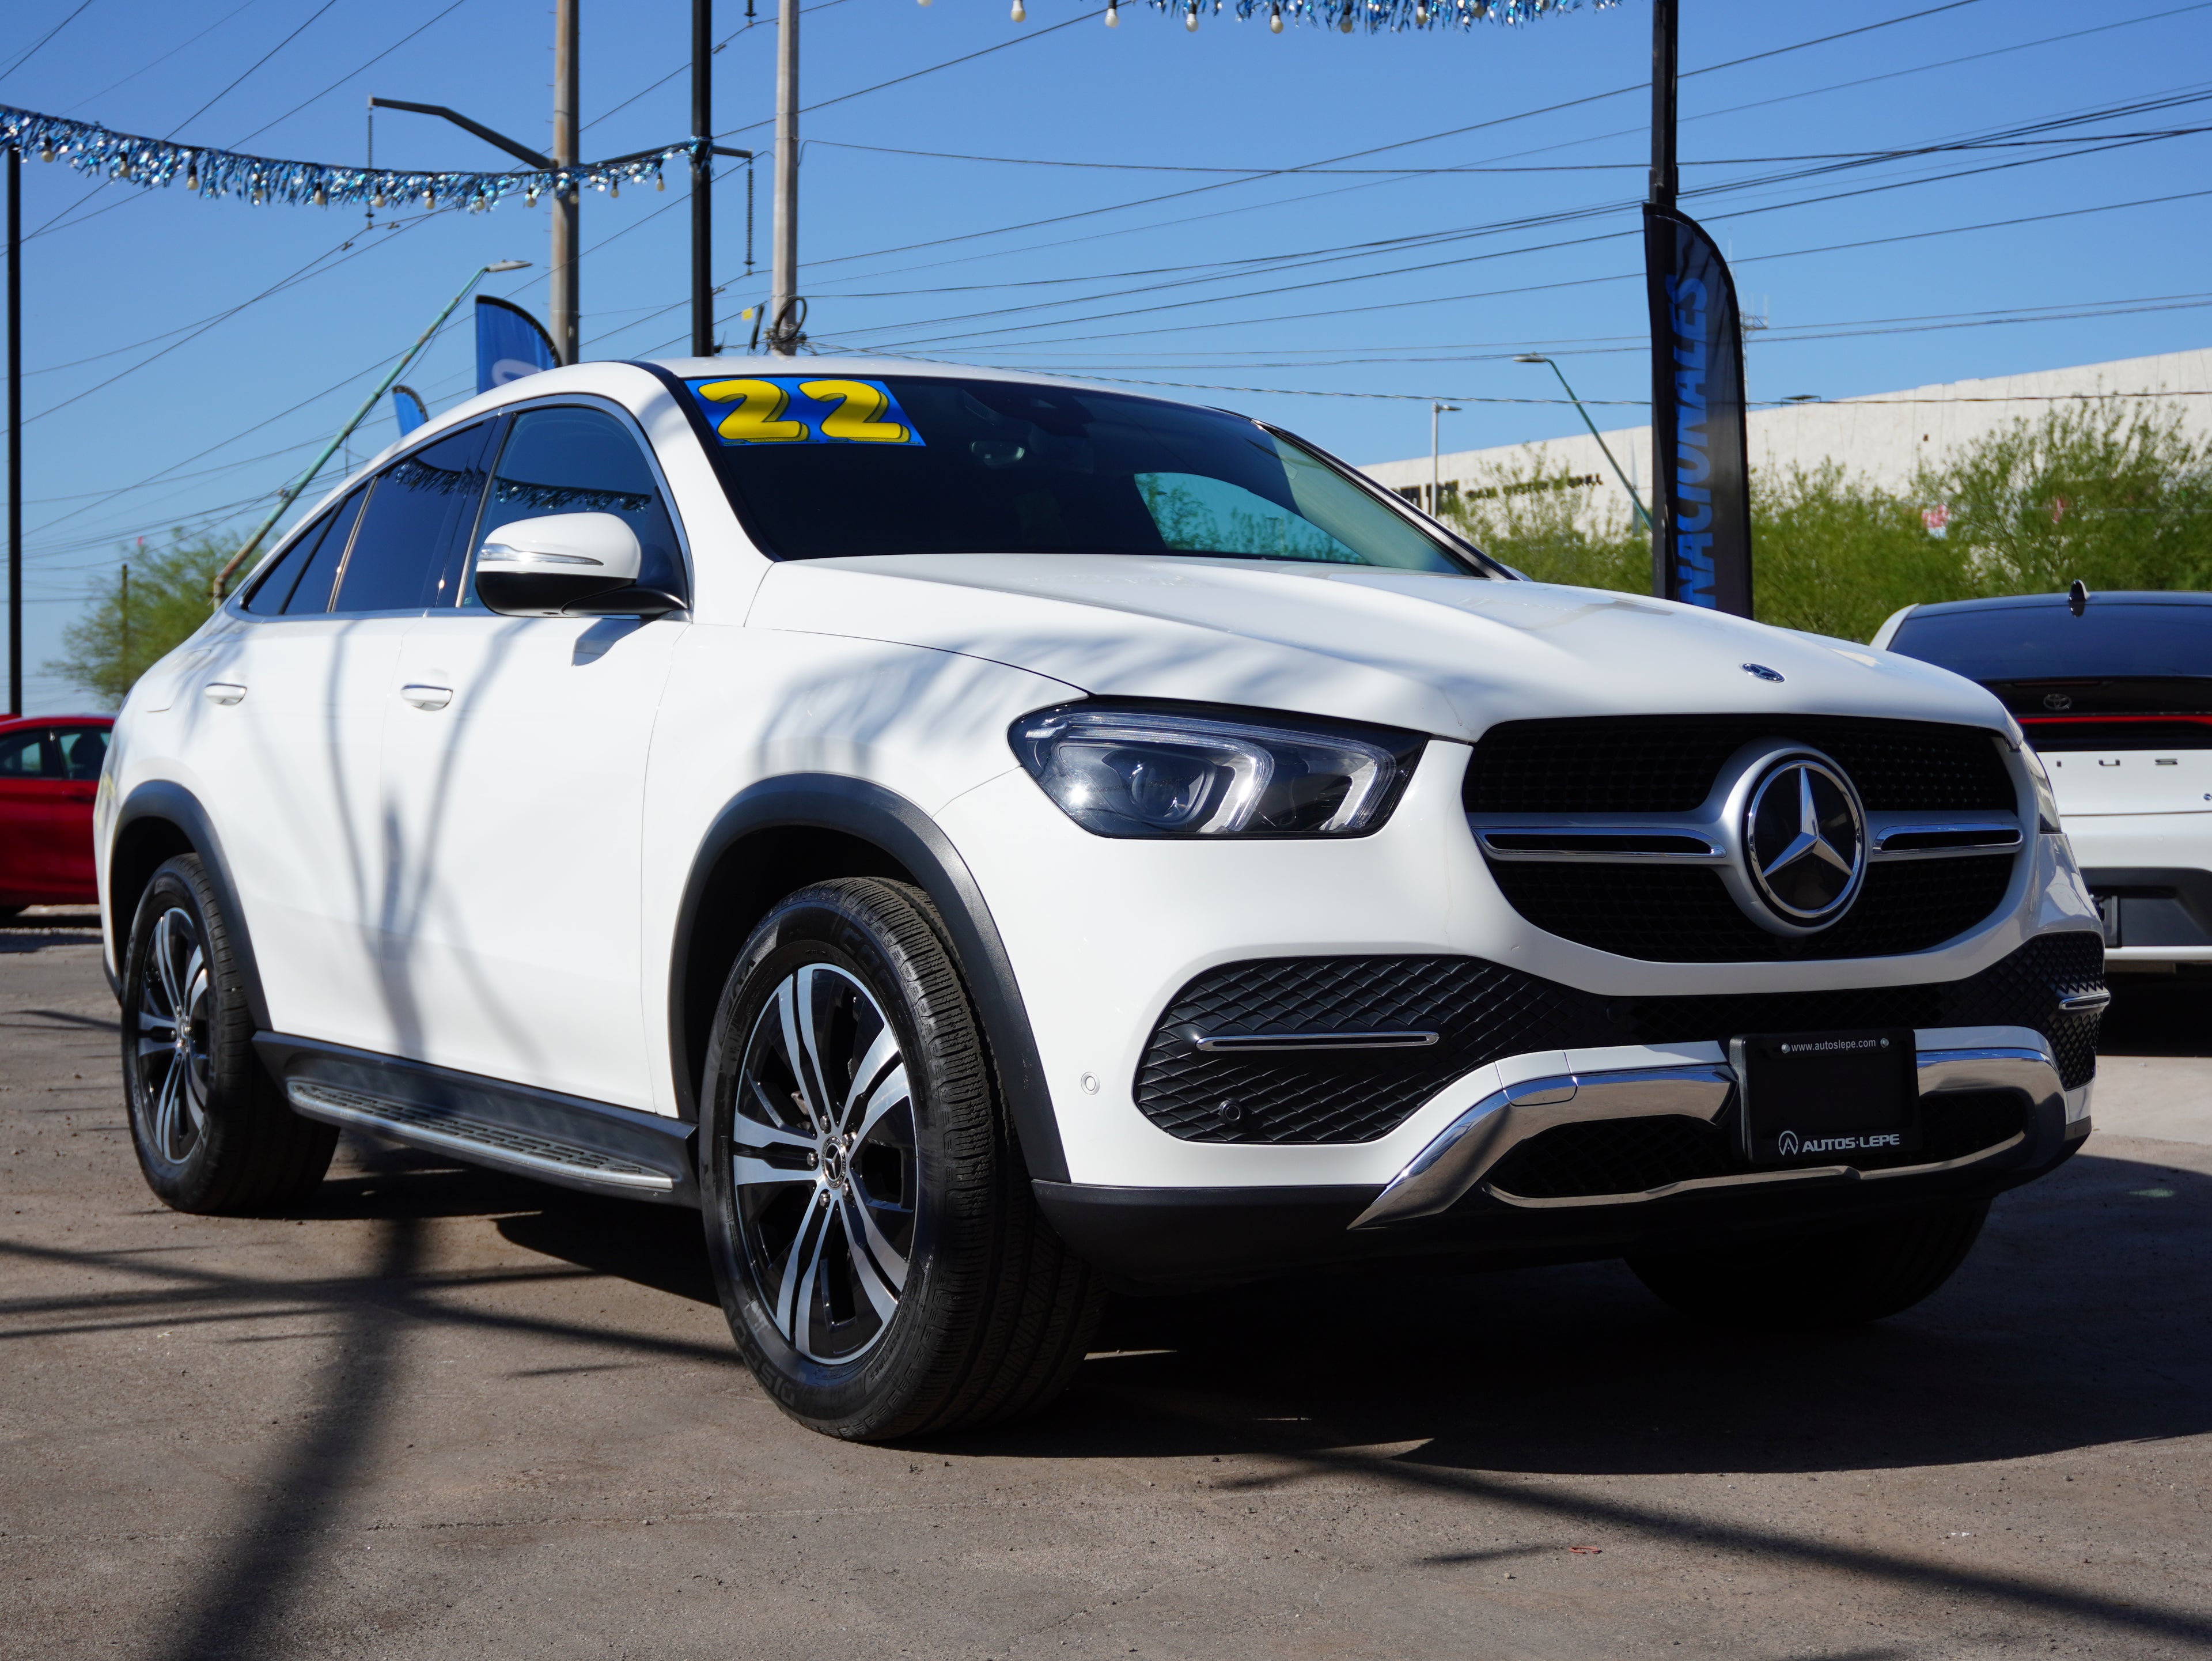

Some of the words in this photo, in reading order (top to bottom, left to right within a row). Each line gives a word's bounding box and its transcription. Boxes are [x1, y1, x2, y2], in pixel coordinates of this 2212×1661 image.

[698, 379, 911, 442] 22
[1666, 274, 1717, 610] NACIONALES
[1791, 1038, 1876, 1052] www.autoslepe.com
